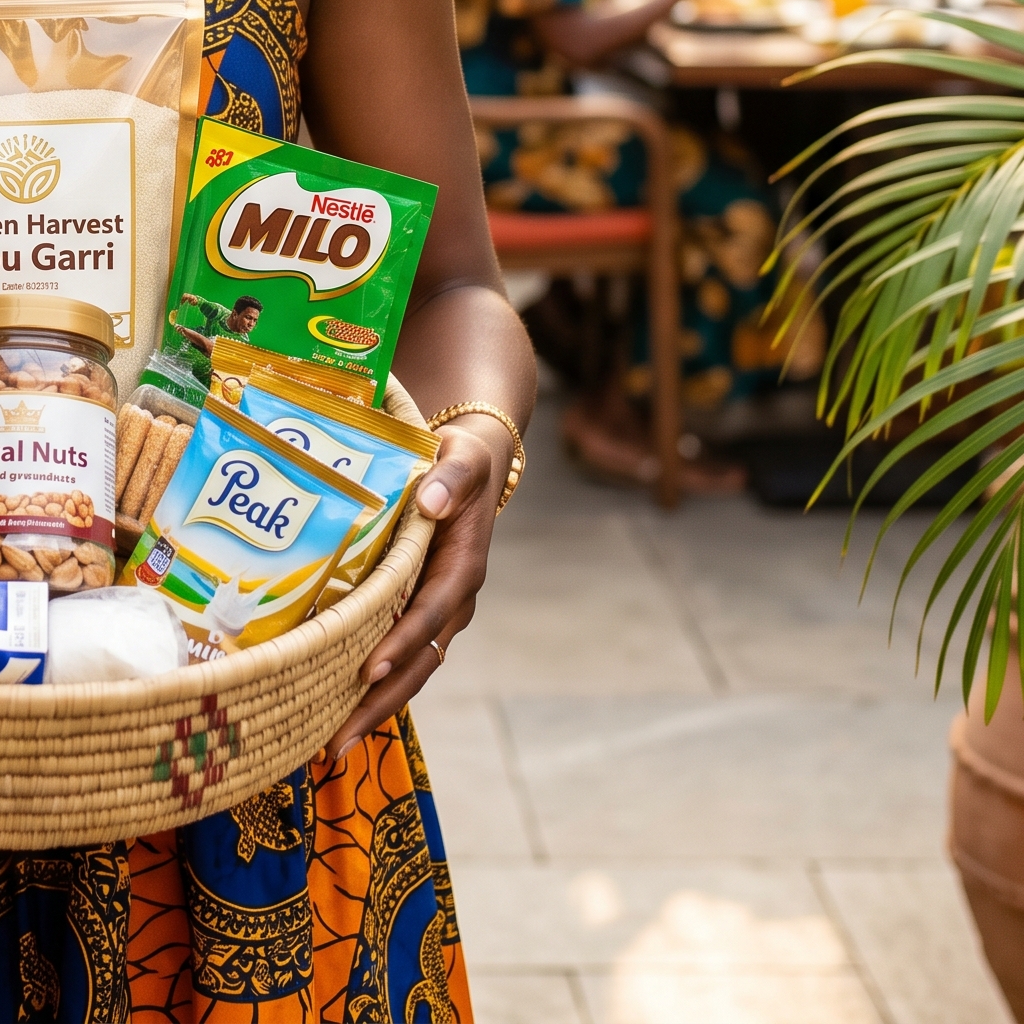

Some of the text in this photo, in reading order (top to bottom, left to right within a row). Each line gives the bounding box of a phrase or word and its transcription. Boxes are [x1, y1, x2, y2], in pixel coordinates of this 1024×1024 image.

[27, 214, 124, 235] Harvest
[228, 202, 371, 270] MILO
[31, 241, 114, 271] Garri
[32, 441, 88, 468] Nuts
[207, 460, 299, 539] Peak
